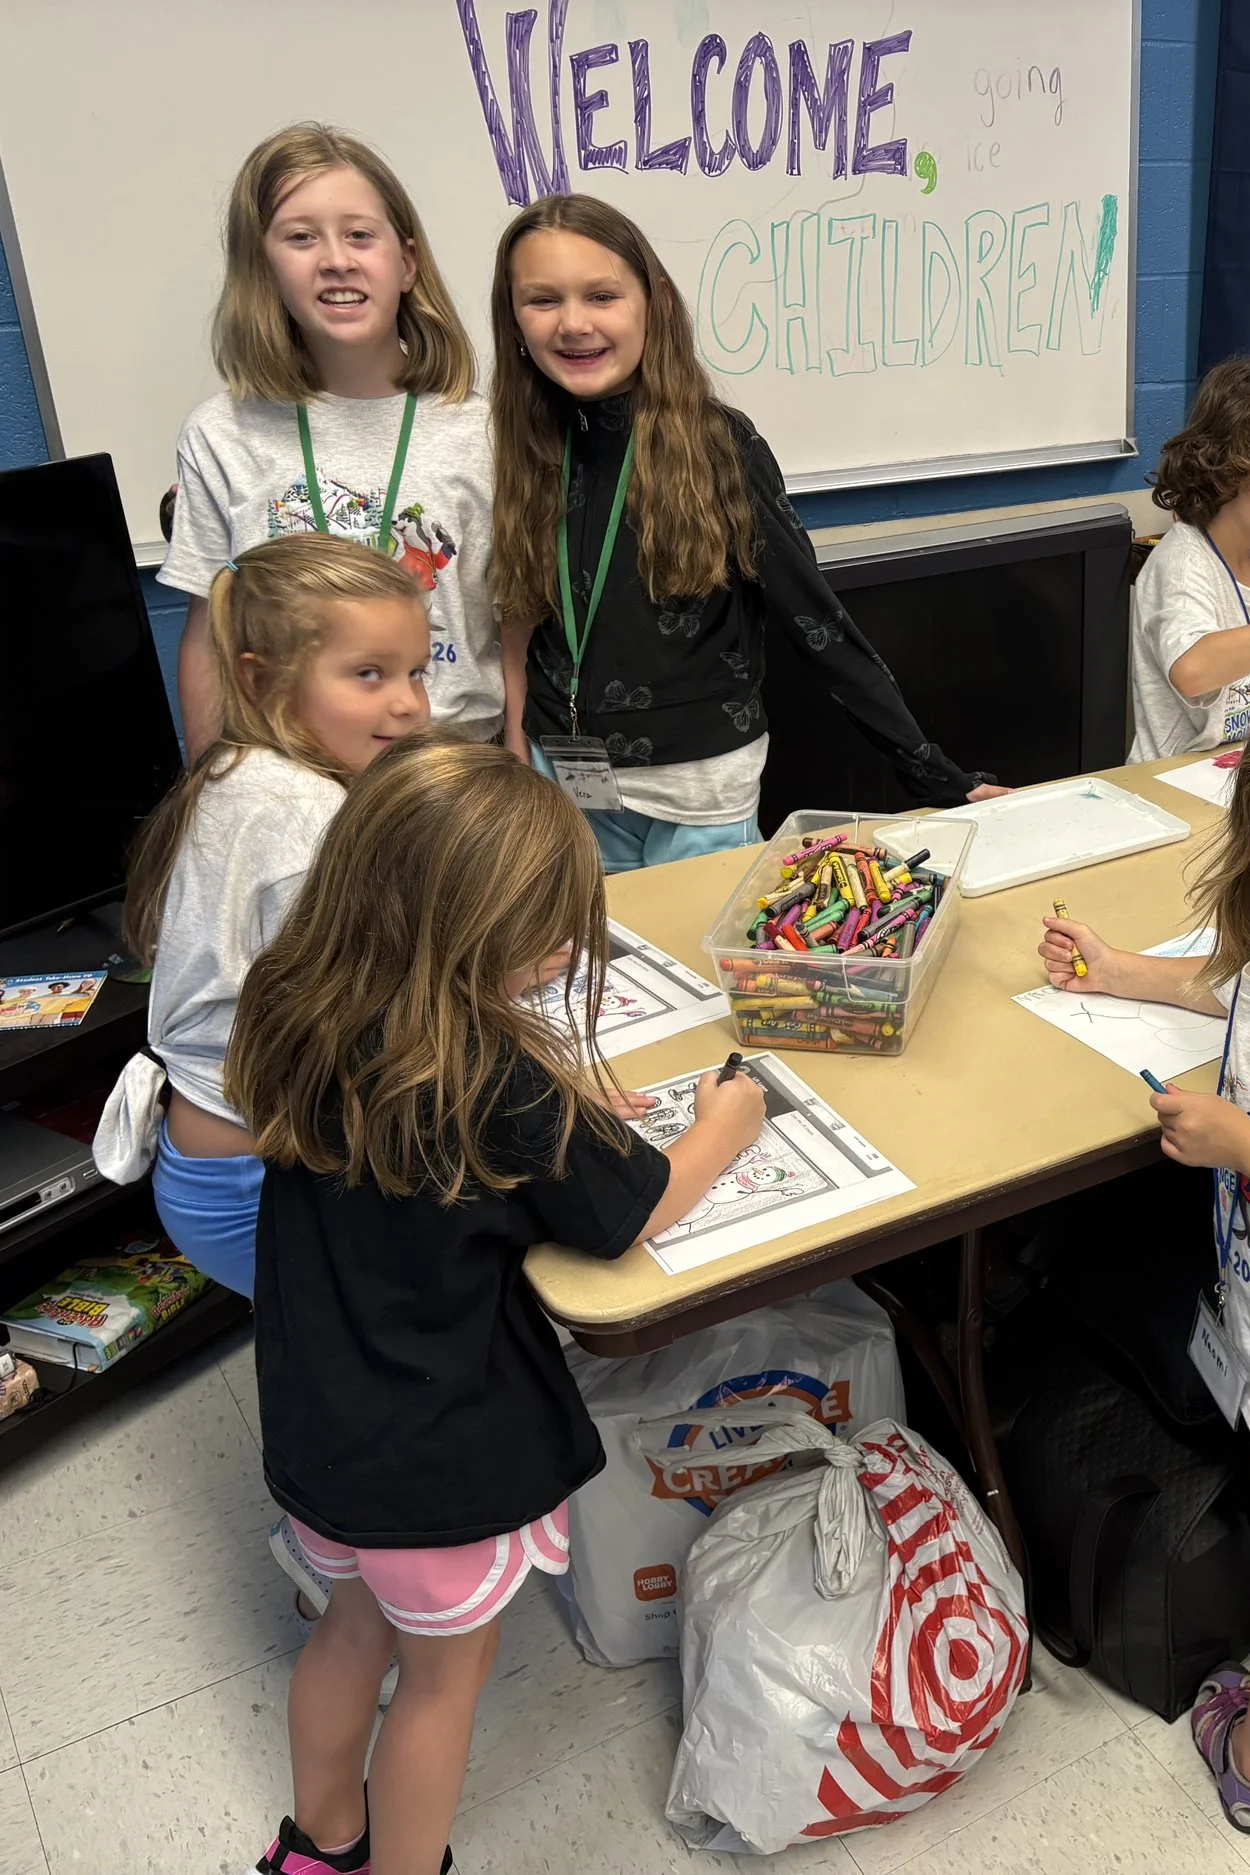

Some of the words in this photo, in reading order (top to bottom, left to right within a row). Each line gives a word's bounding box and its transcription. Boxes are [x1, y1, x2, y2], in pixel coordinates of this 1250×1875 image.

[974, 57, 1065, 128] going
[966, 137, 1001, 172] ice
[697, 194, 1118, 377] CHILDREN
[58, 1296, 110, 1317] BIBLE
[1201, 1327, 1229, 1378] Naomi
[637, 1575, 670, 1587] HOBBY
[642, 1580, 673, 1591] LOBBY
[644, 1611, 671, 1621] Shop
